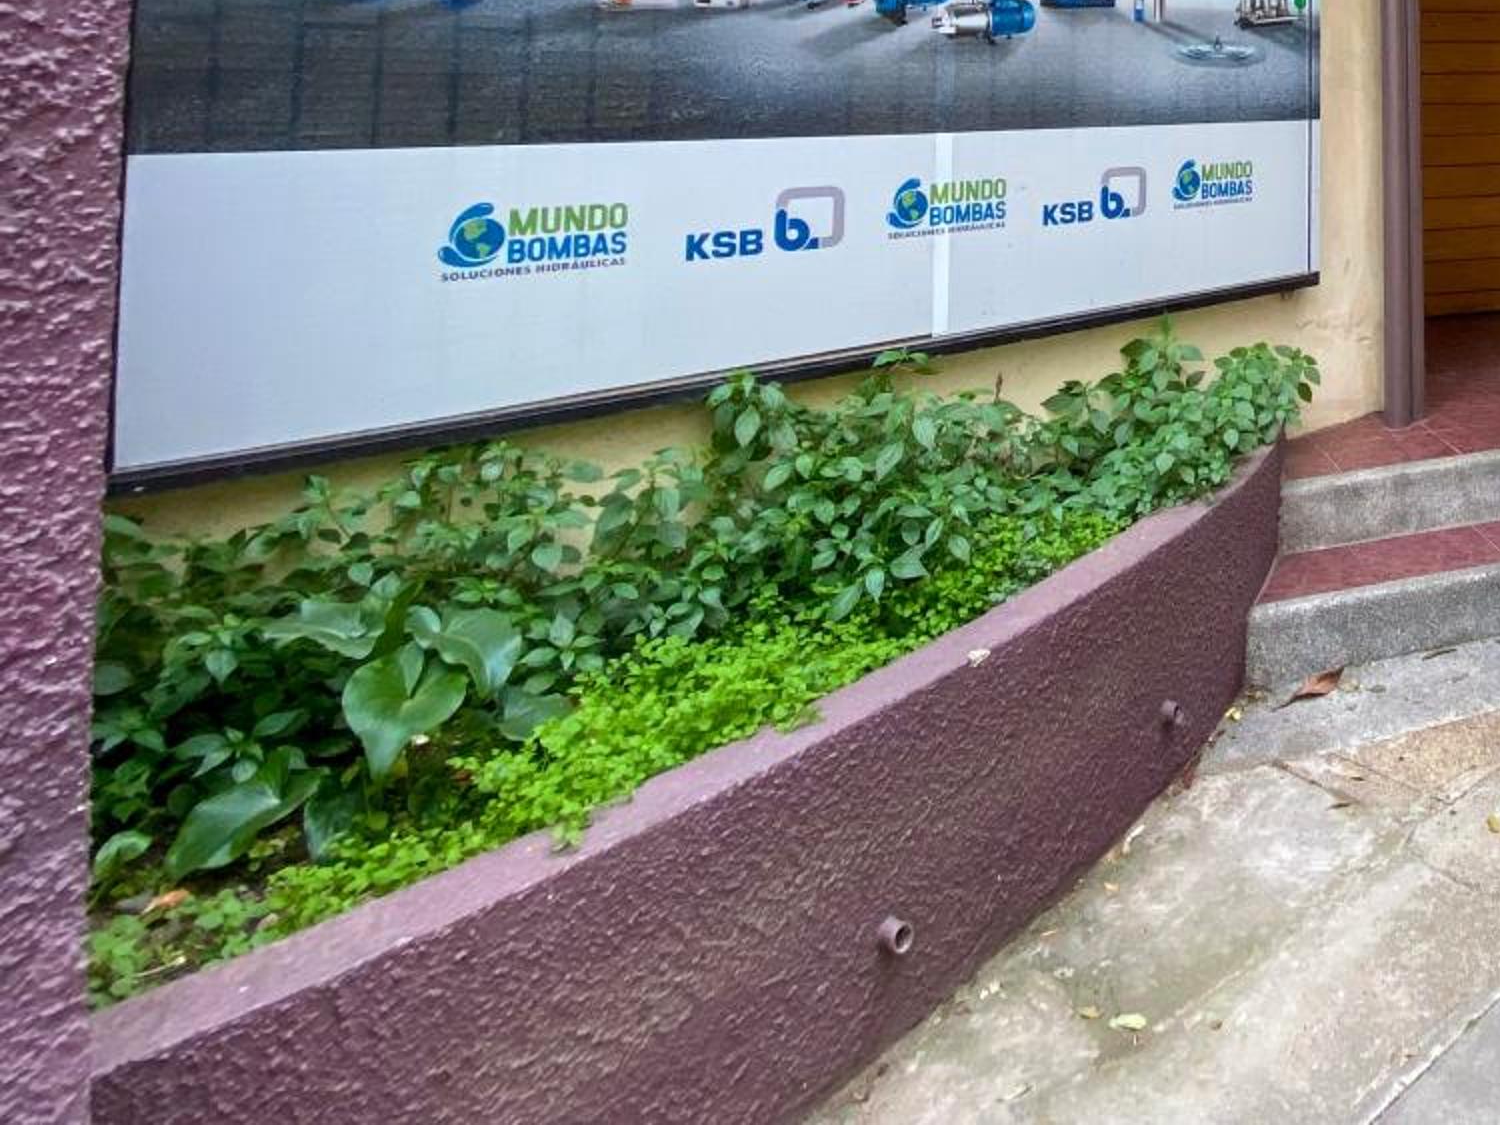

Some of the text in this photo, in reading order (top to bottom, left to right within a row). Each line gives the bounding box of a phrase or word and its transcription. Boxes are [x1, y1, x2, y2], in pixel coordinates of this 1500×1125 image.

[1202, 161, 1253, 181] MUNDO
[930, 178, 1007, 205] MUNDO
[1201, 179, 1253, 200] BOMBAS
[508, 202, 629, 236] MUNDO
[929, 201, 1007, 226] BOMBAS
[1043, 201, 1094, 226] KSB
[507, 231, 628, 264] BOMBAS
[685, 228, 764, 262] KSB
[440, 266, 532, 283] SOLUCIONES
